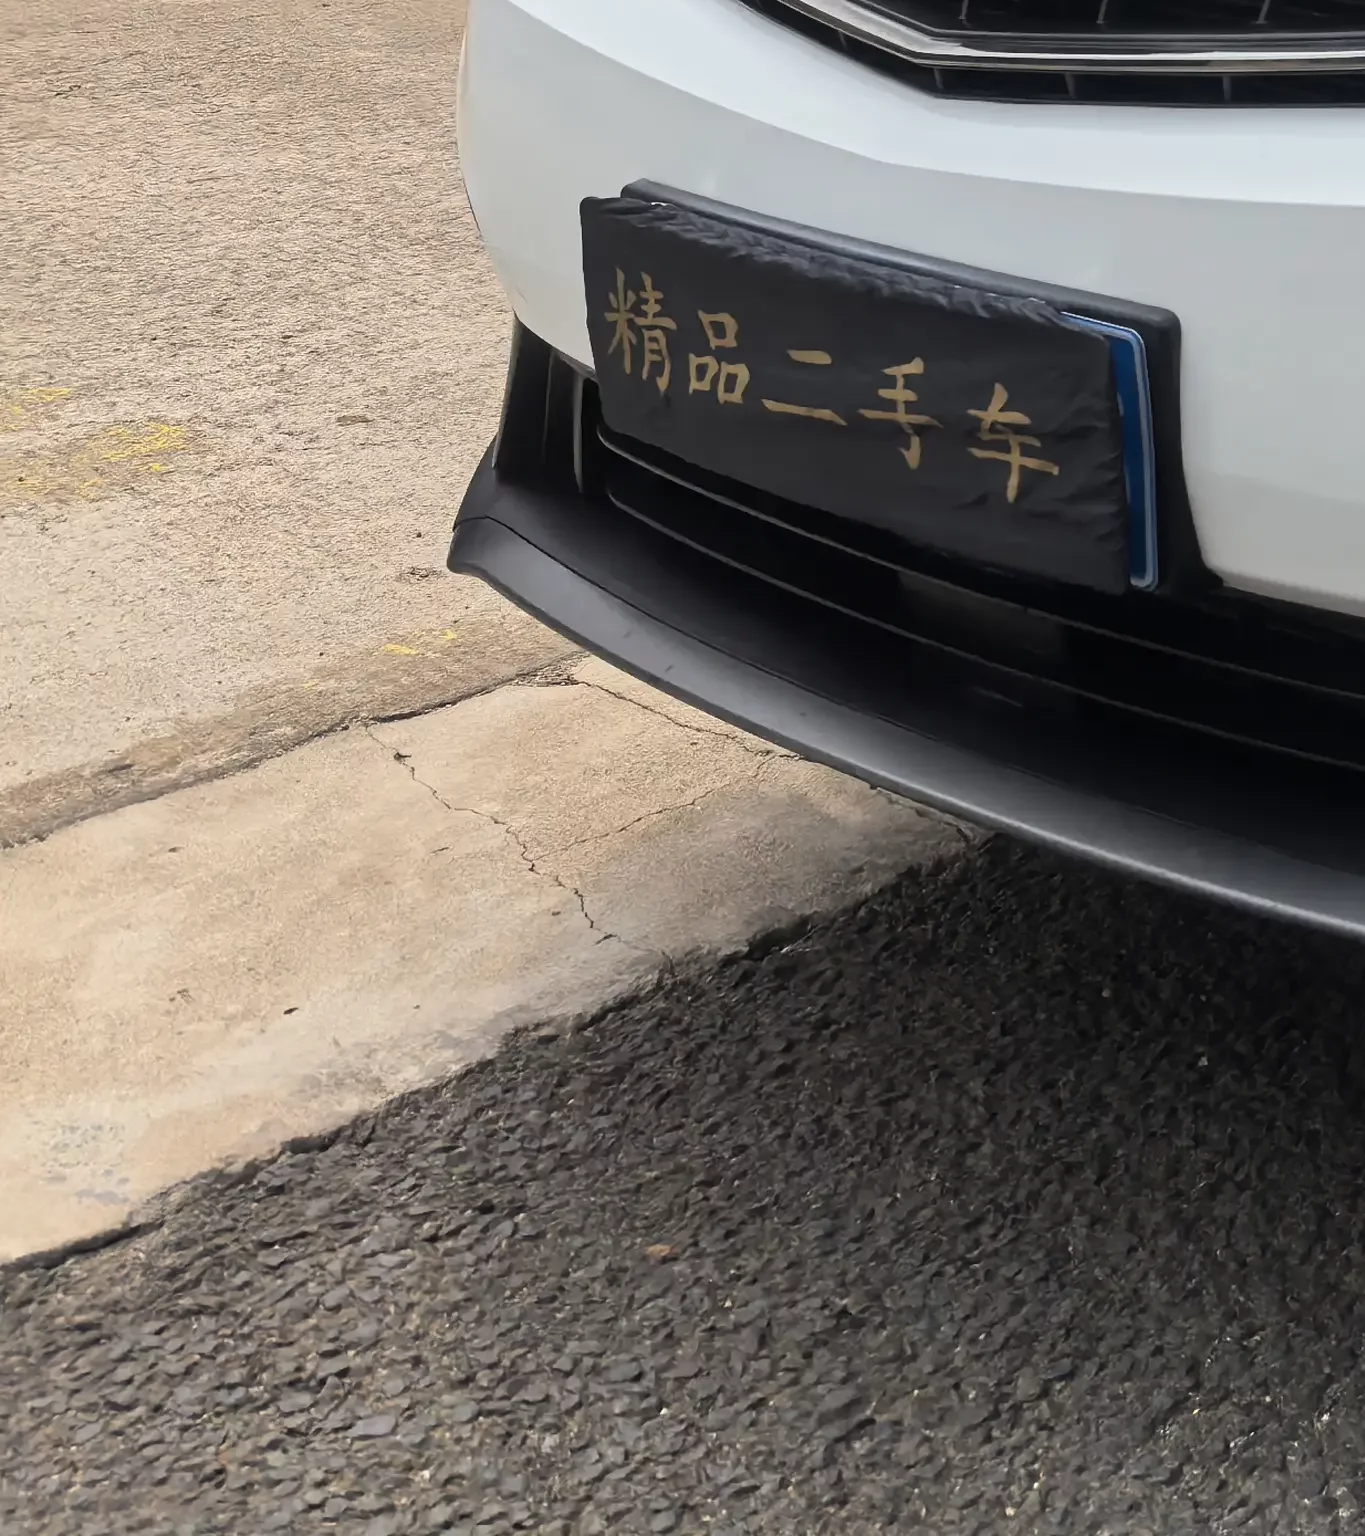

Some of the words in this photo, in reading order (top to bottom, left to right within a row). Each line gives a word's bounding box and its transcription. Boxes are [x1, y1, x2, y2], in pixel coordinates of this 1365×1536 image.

[603, 266, 1060, 503] 精品二手车
